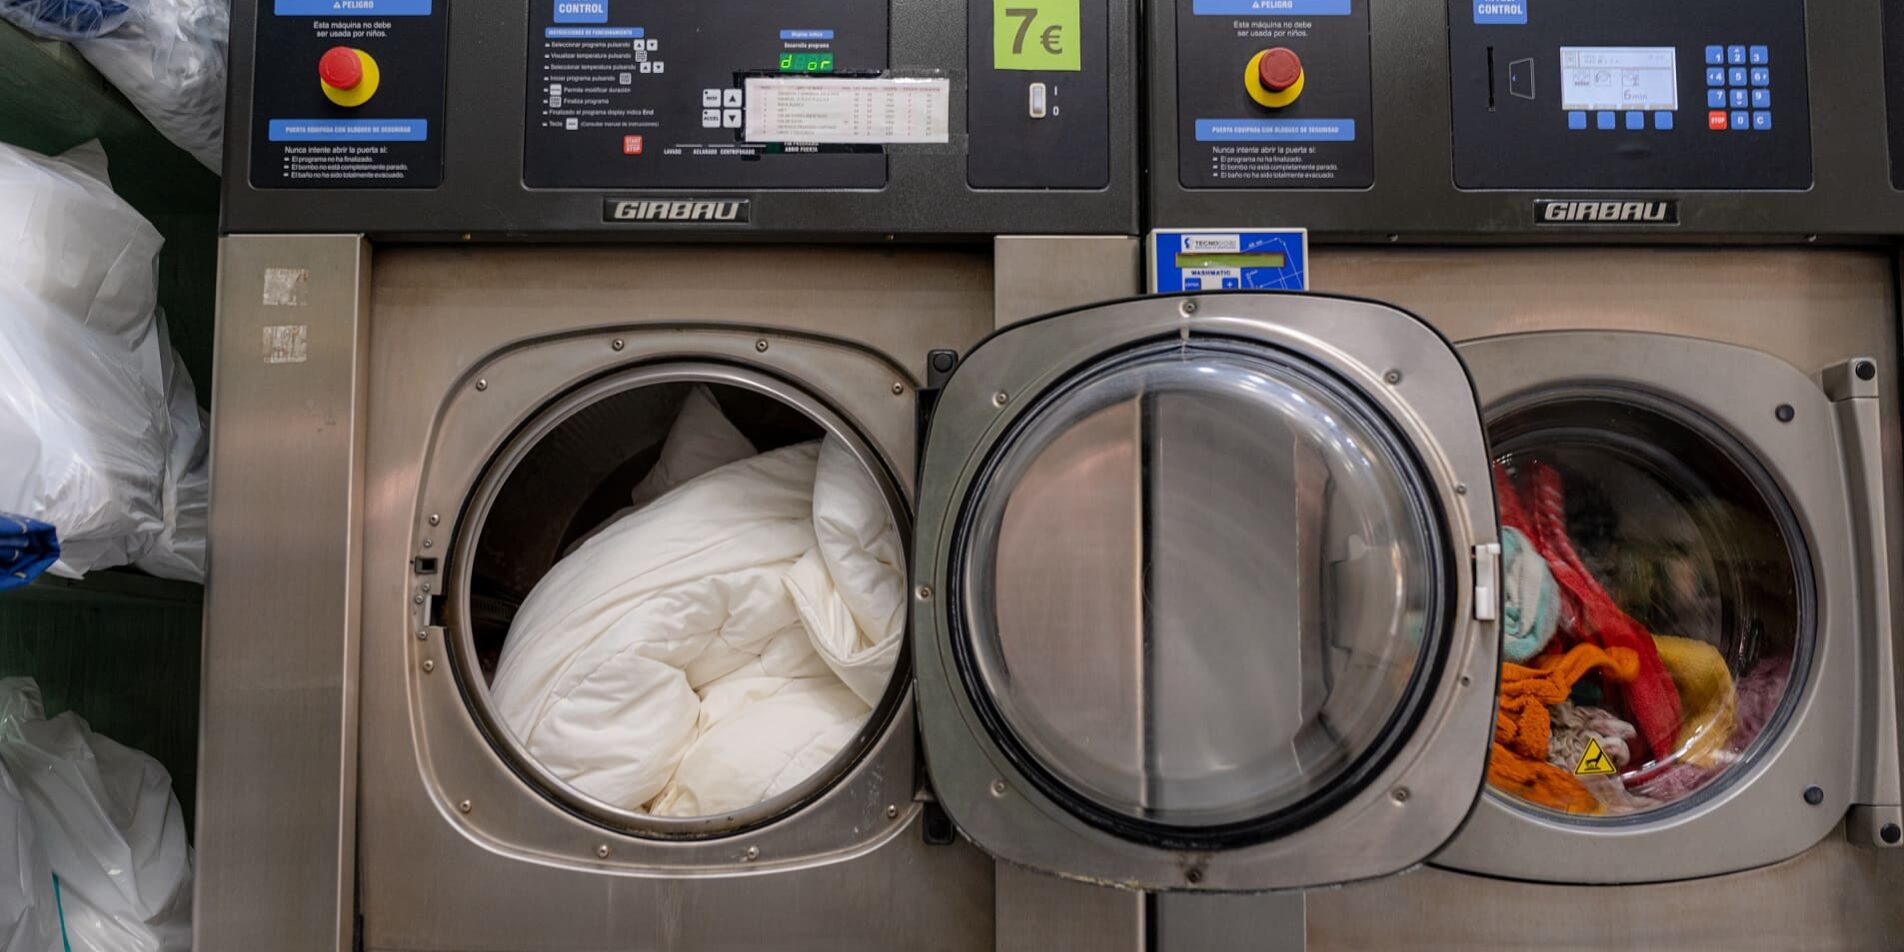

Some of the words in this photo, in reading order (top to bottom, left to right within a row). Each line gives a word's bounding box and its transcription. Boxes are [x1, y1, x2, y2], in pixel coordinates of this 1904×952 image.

[342, 1, 374, 9] PELIGRO
[558, 4, 604, 14] CONTROL
[1261, 1, 1293, 9] PELIGRO
[1478, 4, 1523, 14] CONTROL
[314, 21, 330, 30] Esta
[331, 21, 362, 31] máquina
[374, 21, 392, 30] debe
[1234, 21, 1250, 30] Esta
[1250, 21, 1282, 31] máquina
[1294, 21, 1312, 30] debe
[1716, 54, 1721, 62] 1
[1734, 54, 1740, 62] 2
[1754, 54, 1760, 62] 3
[1716, 72, 1722, 80] 4
[1736, 72, 1742, 80] 5
[1754, 72, 1760, 80] 6
[1716, 92, 1723, 100] 7
[1736, 92, 1742, 100] 8
[1756, 92, 1762, 100] 9
[1757, 116, 1764, 124] C
[356, 146, 378, 154] puerta
[1286, 146, 1307, 154] puerta
[614, 202, 739, 220] GIRBAU
[1544, 202, 1667, 220] GIRBAU
